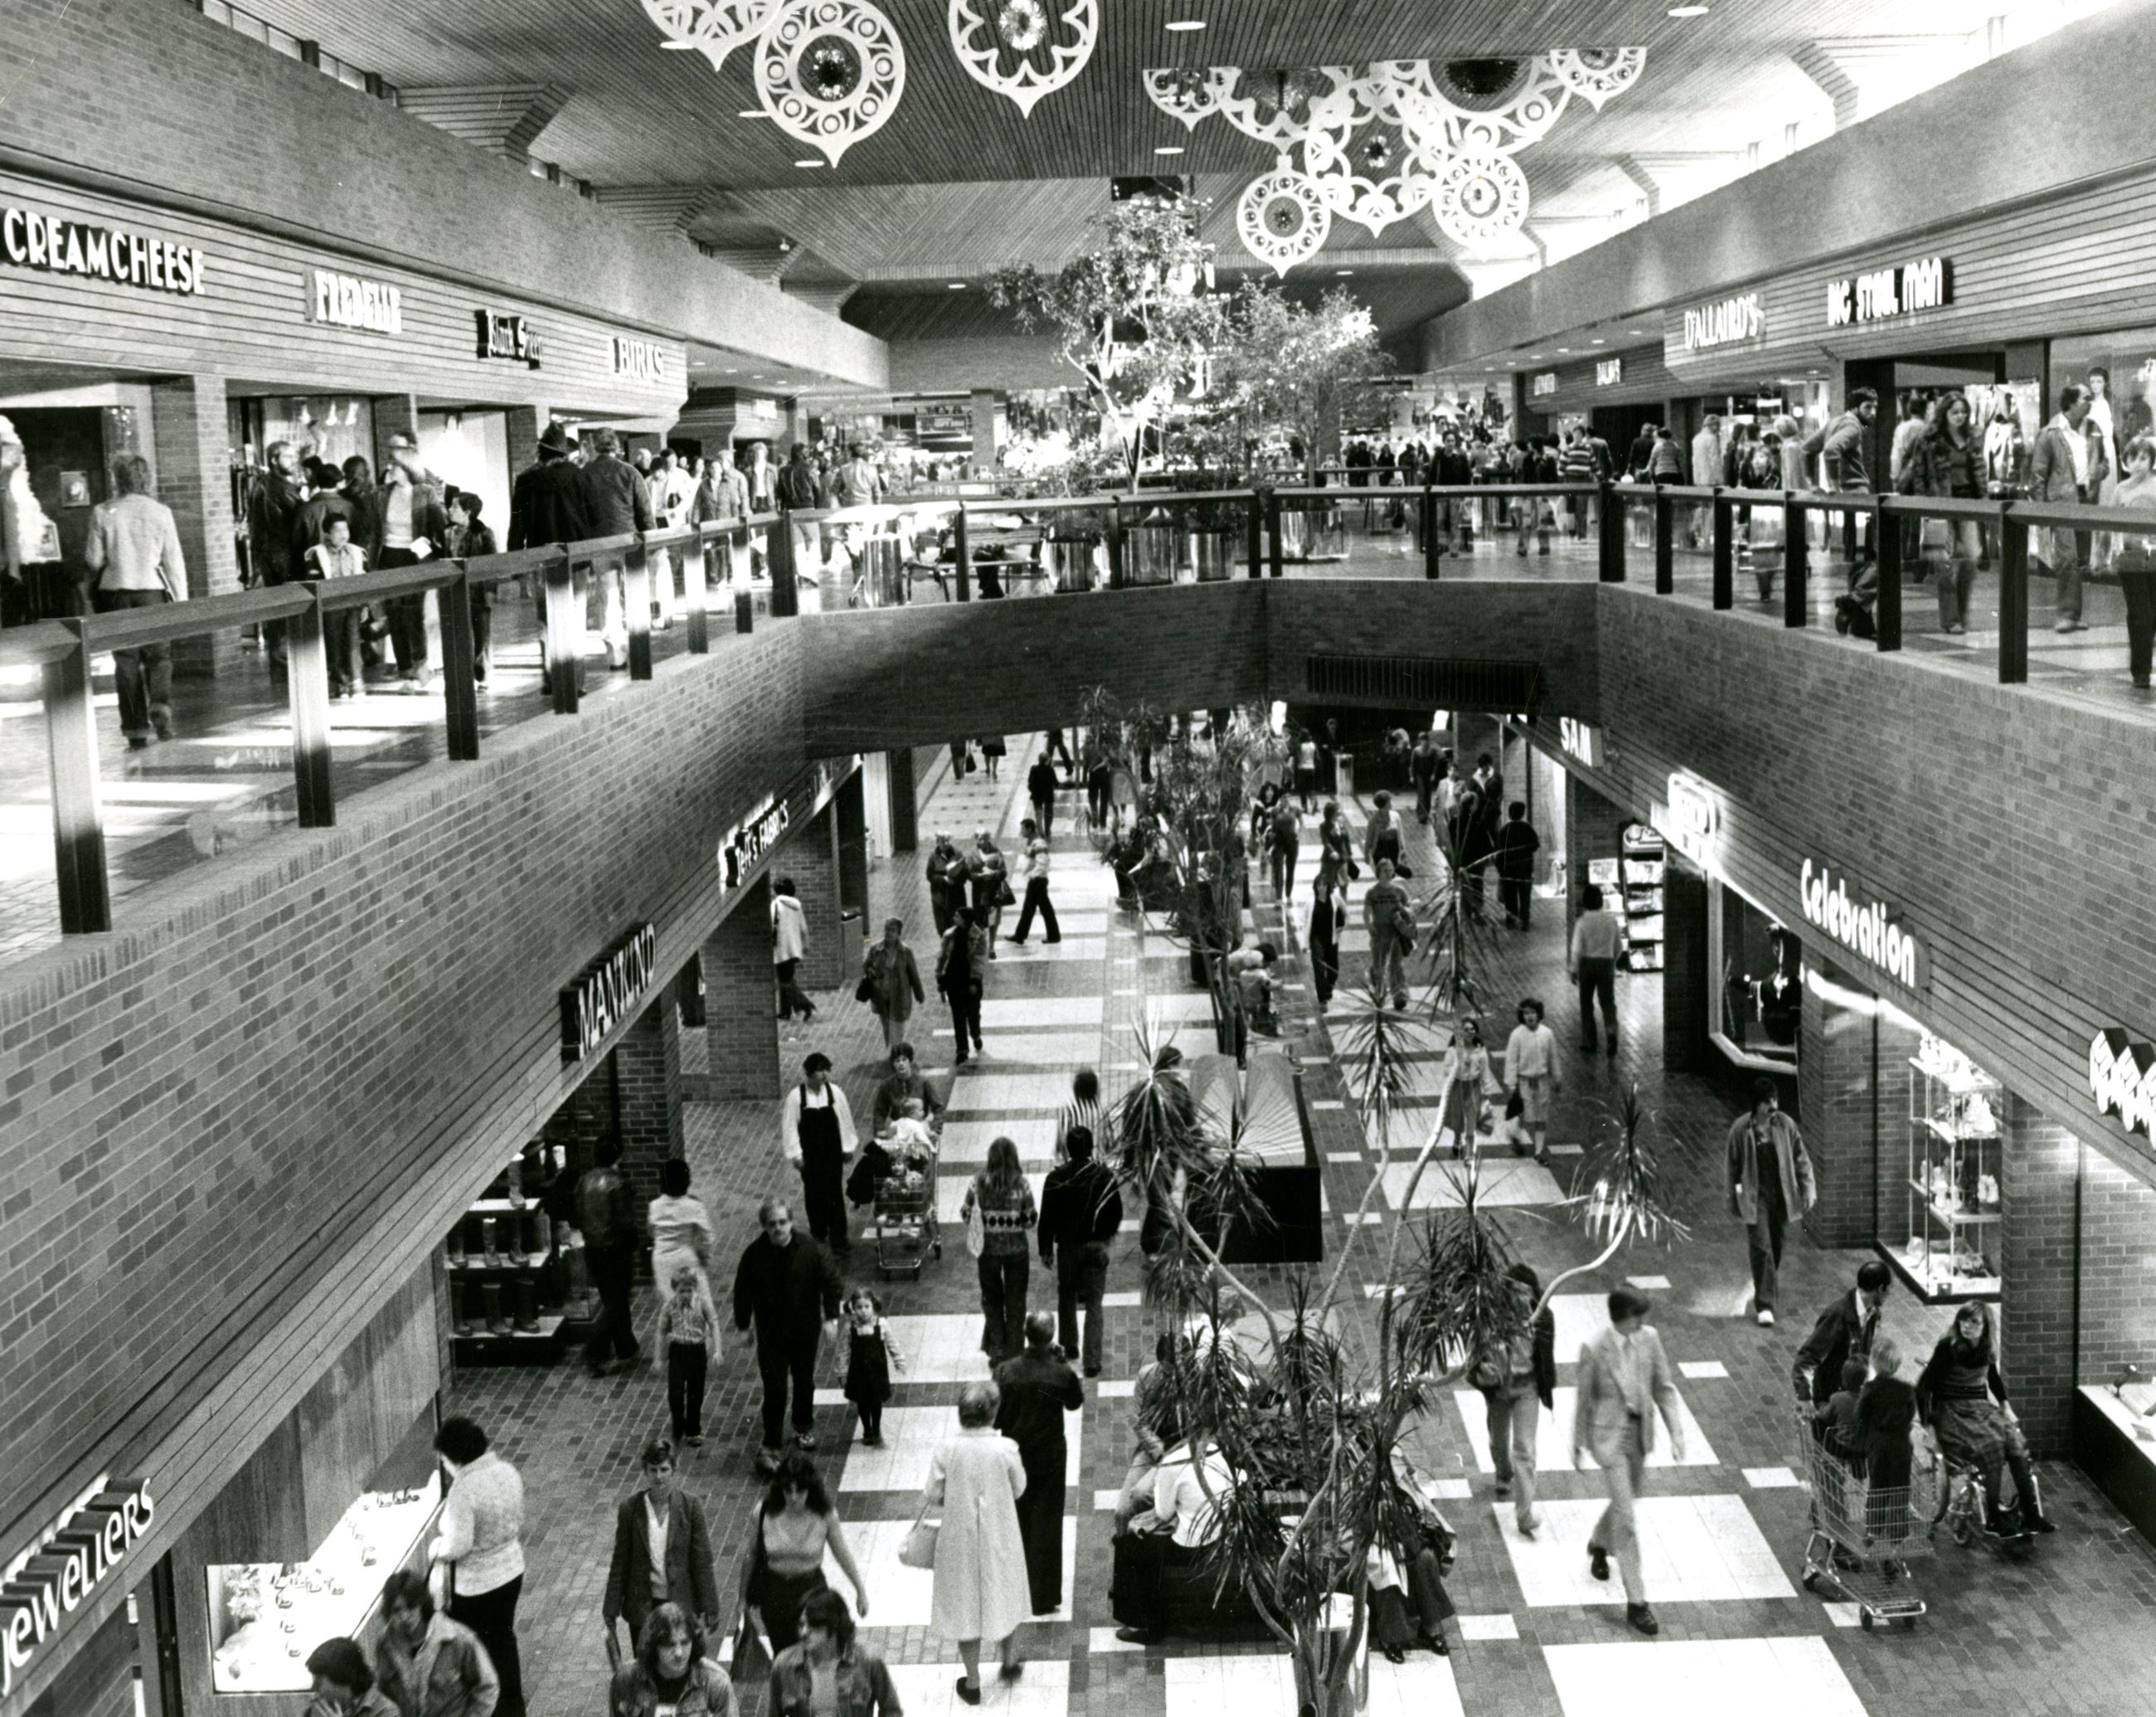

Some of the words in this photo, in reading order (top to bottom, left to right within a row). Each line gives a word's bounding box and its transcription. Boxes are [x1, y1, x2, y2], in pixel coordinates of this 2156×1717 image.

[314, 270, 402, 334] FREDELLE
[1684, 293, 1758, 349] D'ALLAIRD'S
[1828, 280, 1851, 326] BIG
[1857, 269, 1898, 322] STEEL
[618, 338, 663, 381] BIRKS
[1801, 858, 1916, 988] Celebration
[579, 922, 656, 1061] MANKIND
